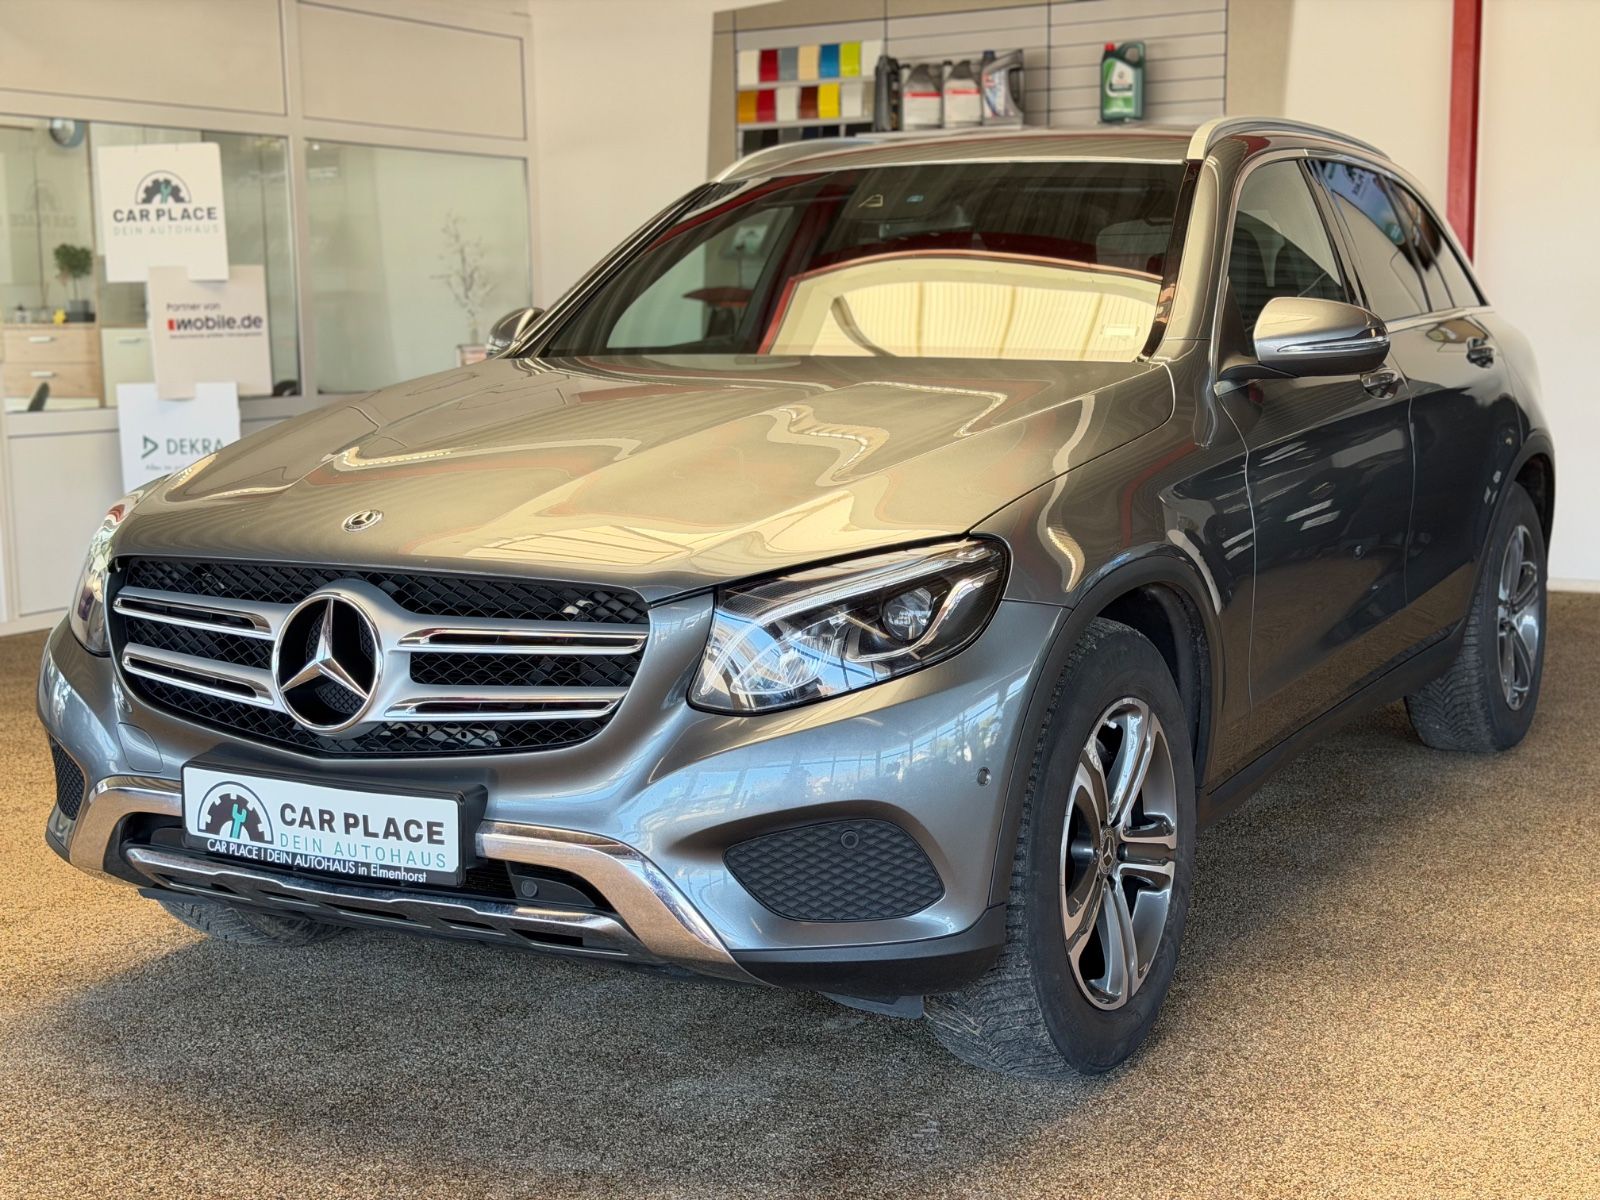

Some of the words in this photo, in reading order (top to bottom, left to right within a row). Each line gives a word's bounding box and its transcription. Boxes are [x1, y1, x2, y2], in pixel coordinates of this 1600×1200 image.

[113, 208, 151, 223] CAR
[156, 206, 217, 222] PLACE
[113, 226, 142, 236] DEIN
[149, 224, 219, 235] AUTOHAUS
[176, 314, 263, 331] mobile.de
[166, 438, 224, 455] DEKRA
[279, 802, 336, 833] CAR
[343, 812, 445, 845] PLACE
[280, 833, 322, 853] DEIN
[334, 841, 446, 868] AUTOHAUS
[207, 839, 227, 853] CAR
[229, 844, 258, 859] PLACE
[267, 850, 292, 864] DEIN
[294, 853, 356, 874] AUTOHAUS
[358, 863, 368, 876] in
[370, 864, 427, 883] Elmenhorst
